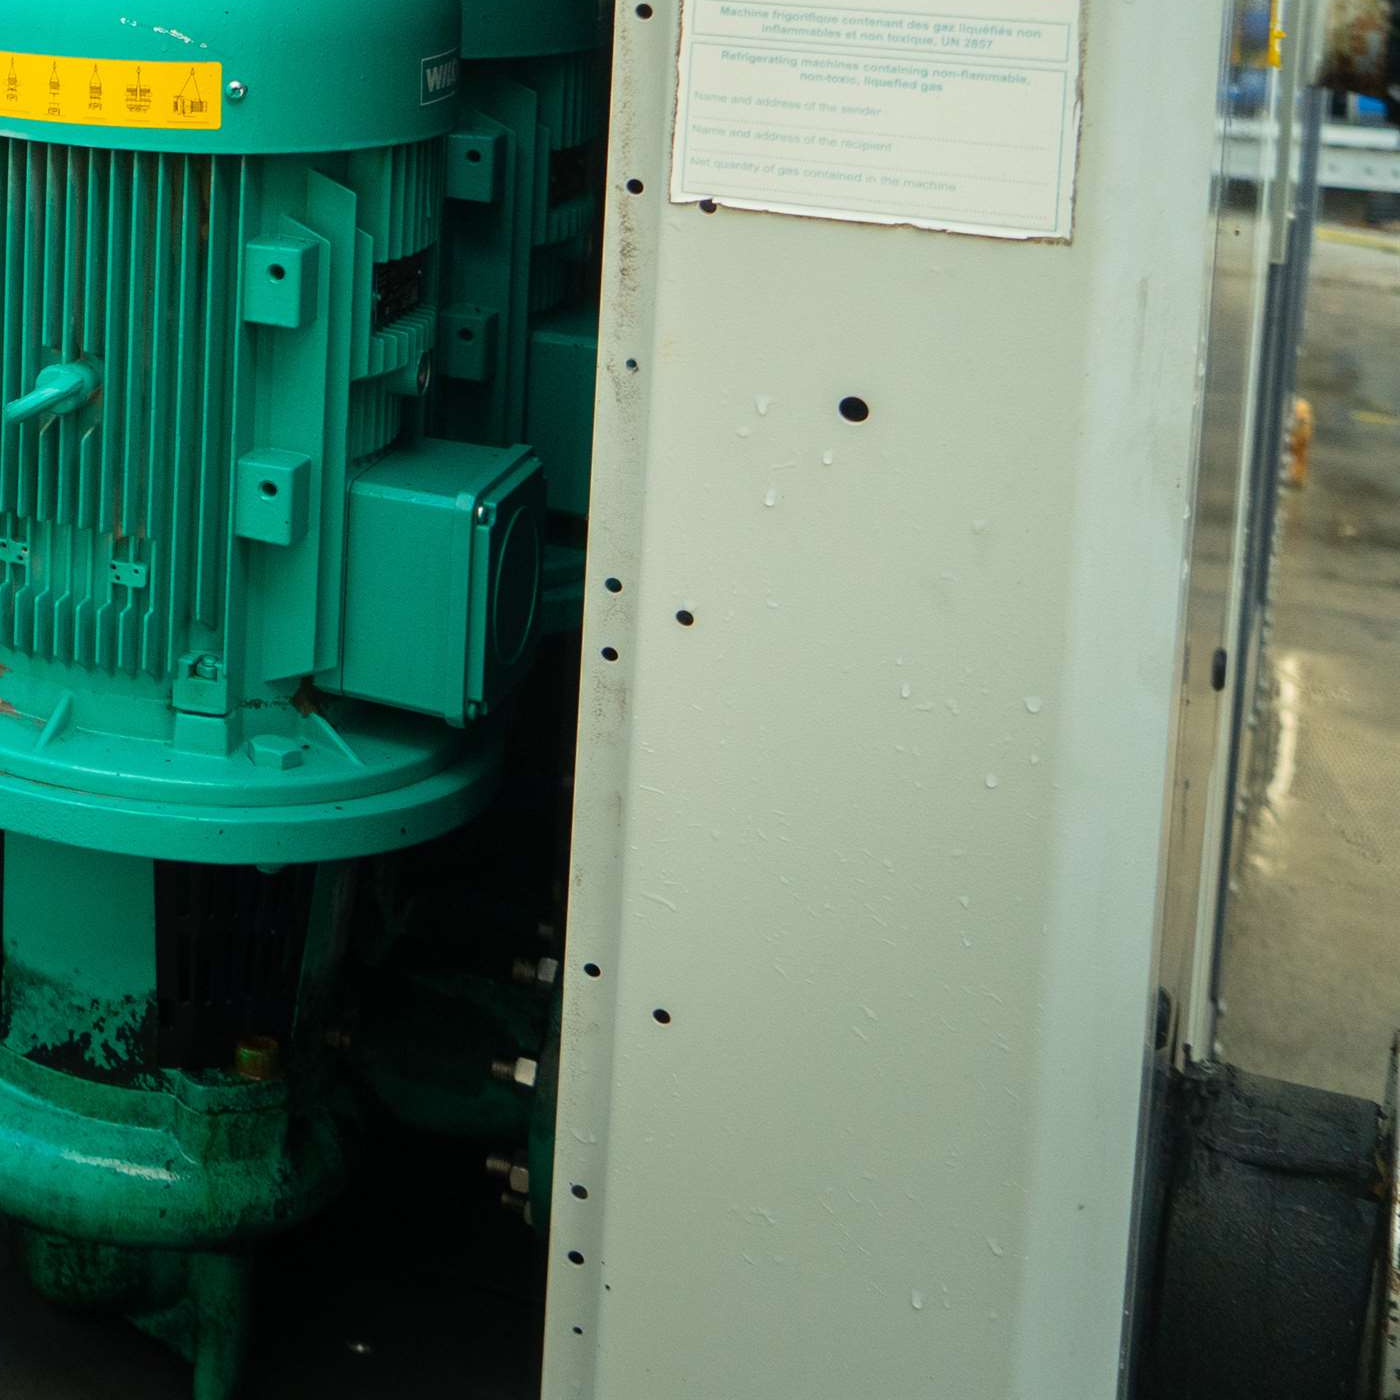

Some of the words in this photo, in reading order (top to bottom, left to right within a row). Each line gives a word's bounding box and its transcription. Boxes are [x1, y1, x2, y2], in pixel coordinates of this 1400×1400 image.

[720, 6, 769, 19] Machine
[772, 10, 838, 25] frigorifique
[841, 17, 903, 30] contenant
[906, 20, 929, 31] des
[932, 23, 956, 34] gaz
[1016, 28, 1042, 39] non
[761, 23, 840, 39] inflammables
[845, 30, 857, 40] et
[860, 32, 884, 41] non
[941, 36, 960, 47] UN
[964, 38, 993, 49] 2857
[720, 50, 798, 69] Refrigerating
[801, 58, 859, 71] machines
[863, 64, 929, 79] containing
[864, 76, 918, 89] liquefied
[920, 82, 944, 93] gas
[694, 91, 728, 104] Name
[730, 95, 752, 106] and
[754, 97, 801, 110] address
[803, 102, 817, 112] of
[818, 102, 838, 113] the
[841, 105, 882, 117] sender
[692, 124, 726, 137] Name
[728, 128, 751, 139] and
[753, 130, 802, 144] address
[804, 134, 817, 145] of
[818, 135, 839, 147] the
[841, 138, 893, 153] recipient
[689, 157, 711, 168] Net
[713, 160, 759, 174] quantity
[761, 164, 776, 174] of
[777, 166, 800, 177] gas
[803, 168, 863, 182] contained
[865, 175, 878, 185] in
[880, 175, 900, 186] the
[903, 178, 956, 192] machine
